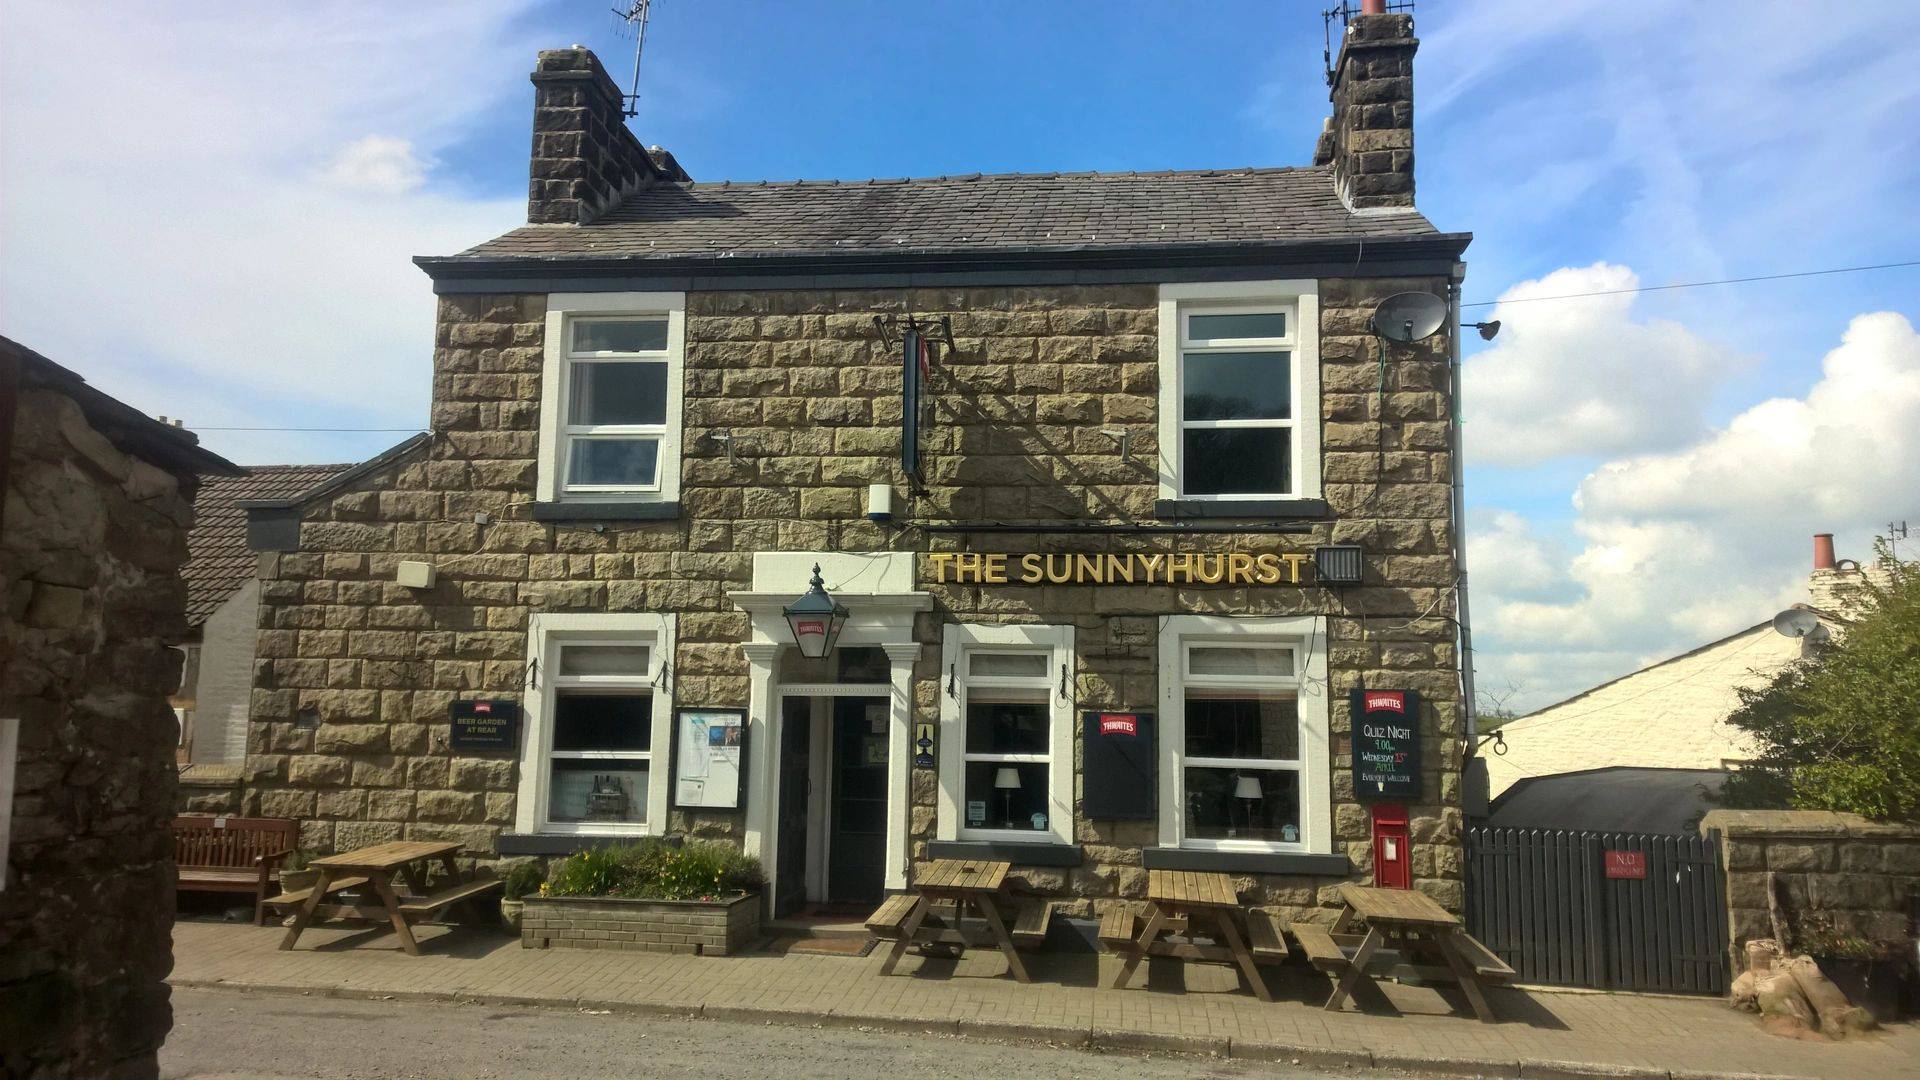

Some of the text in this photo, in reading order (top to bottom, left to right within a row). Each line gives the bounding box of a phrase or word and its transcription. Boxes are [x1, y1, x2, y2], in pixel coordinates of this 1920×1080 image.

[930, 553, 1308, 584] THE SUNNYHURST
[1368, 698, 1401, 709] THWAITES
[1103, 721, 1134, 731] THWAITES
